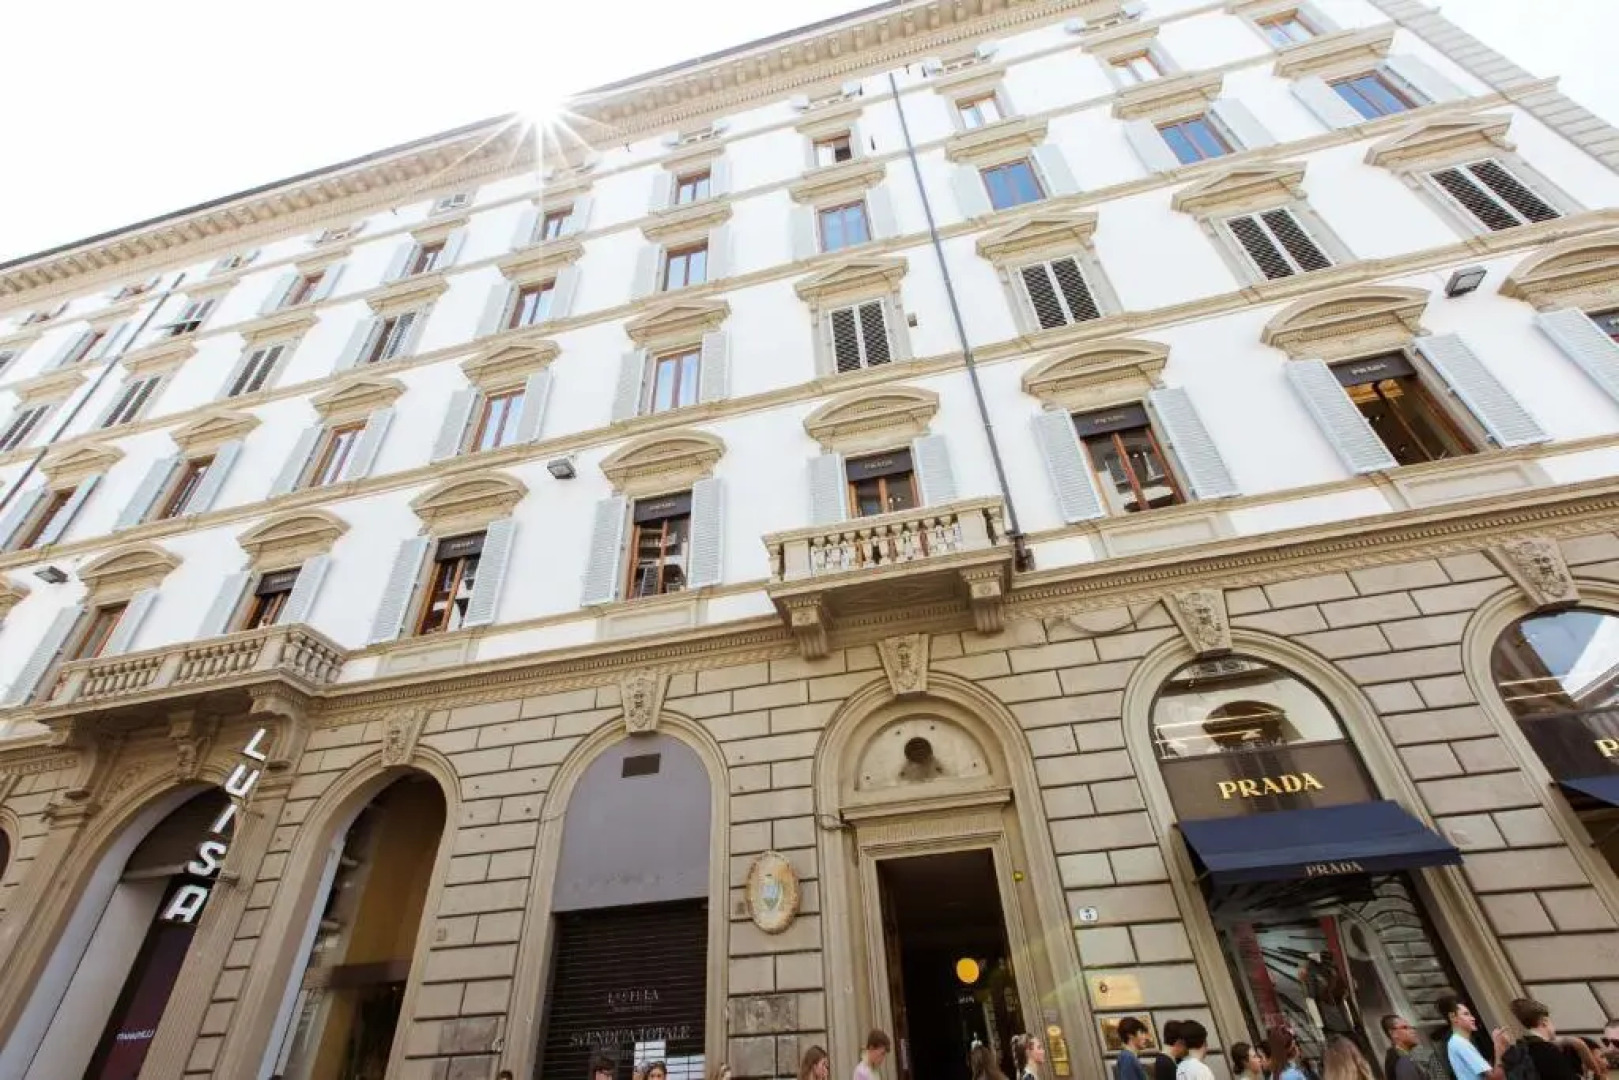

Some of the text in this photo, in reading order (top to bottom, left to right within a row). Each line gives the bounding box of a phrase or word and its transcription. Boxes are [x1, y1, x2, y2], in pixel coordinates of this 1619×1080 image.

[1216, 772, 1325, 800] PRADA
[162, 728, 267, 923] LUISA
[1305, 861, 1363, 877] PRADA
